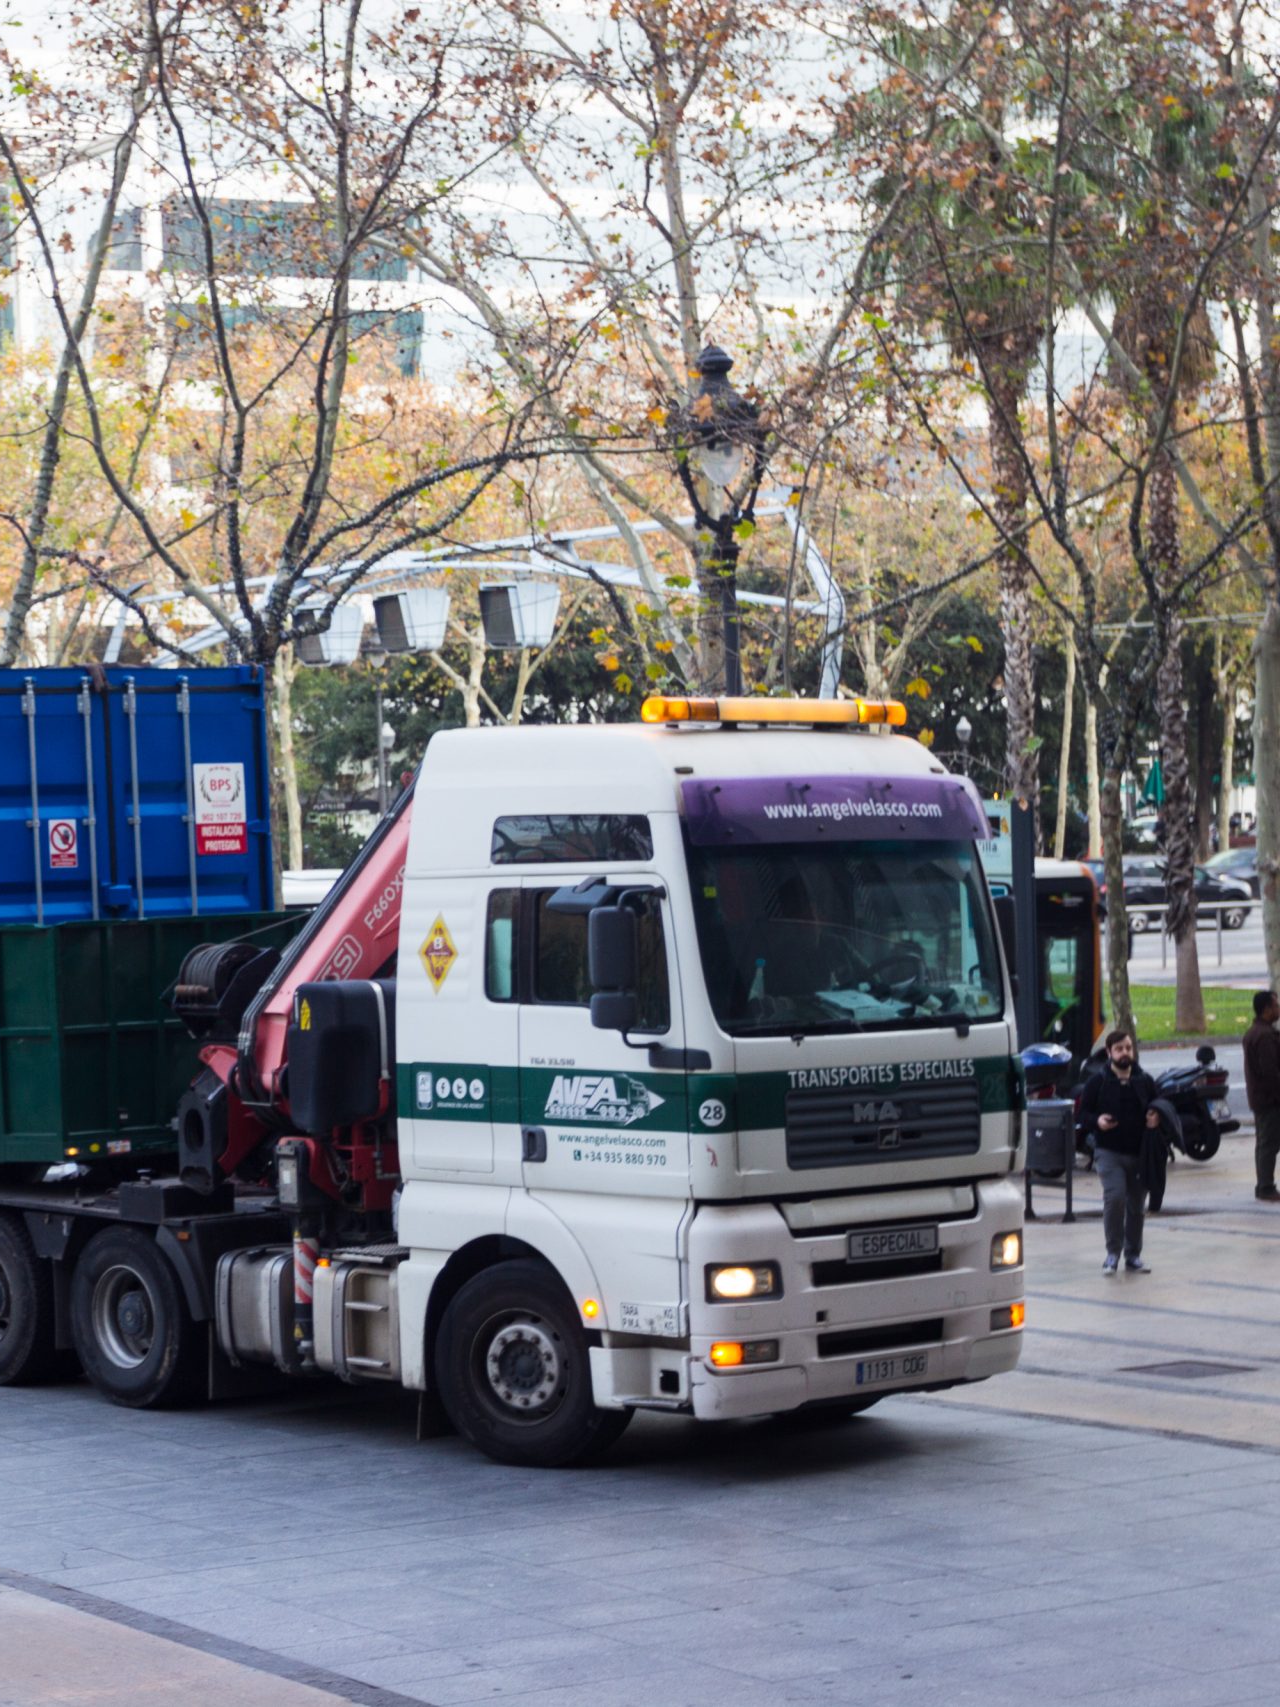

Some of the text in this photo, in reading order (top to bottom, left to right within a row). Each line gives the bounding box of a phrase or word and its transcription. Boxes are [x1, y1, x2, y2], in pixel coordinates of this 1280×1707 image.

[210, 779, 231, 791] BPS
[763, 797, 942, 821] www.angelvelasco.com
[788, 1059, 975, 1089] TRANSPORTES ESPECIALES
[702, 1104, 724, 1120] 28
[558, 1133, 666, 1147] www.angelvelasco.com
[604, 1152, 622, 1164] 935
[647, 1154, 667, 1166] 970
[862, 1231, 924, 1255] ESPECIAL
[867, 1360, 895, 1380] 1131
